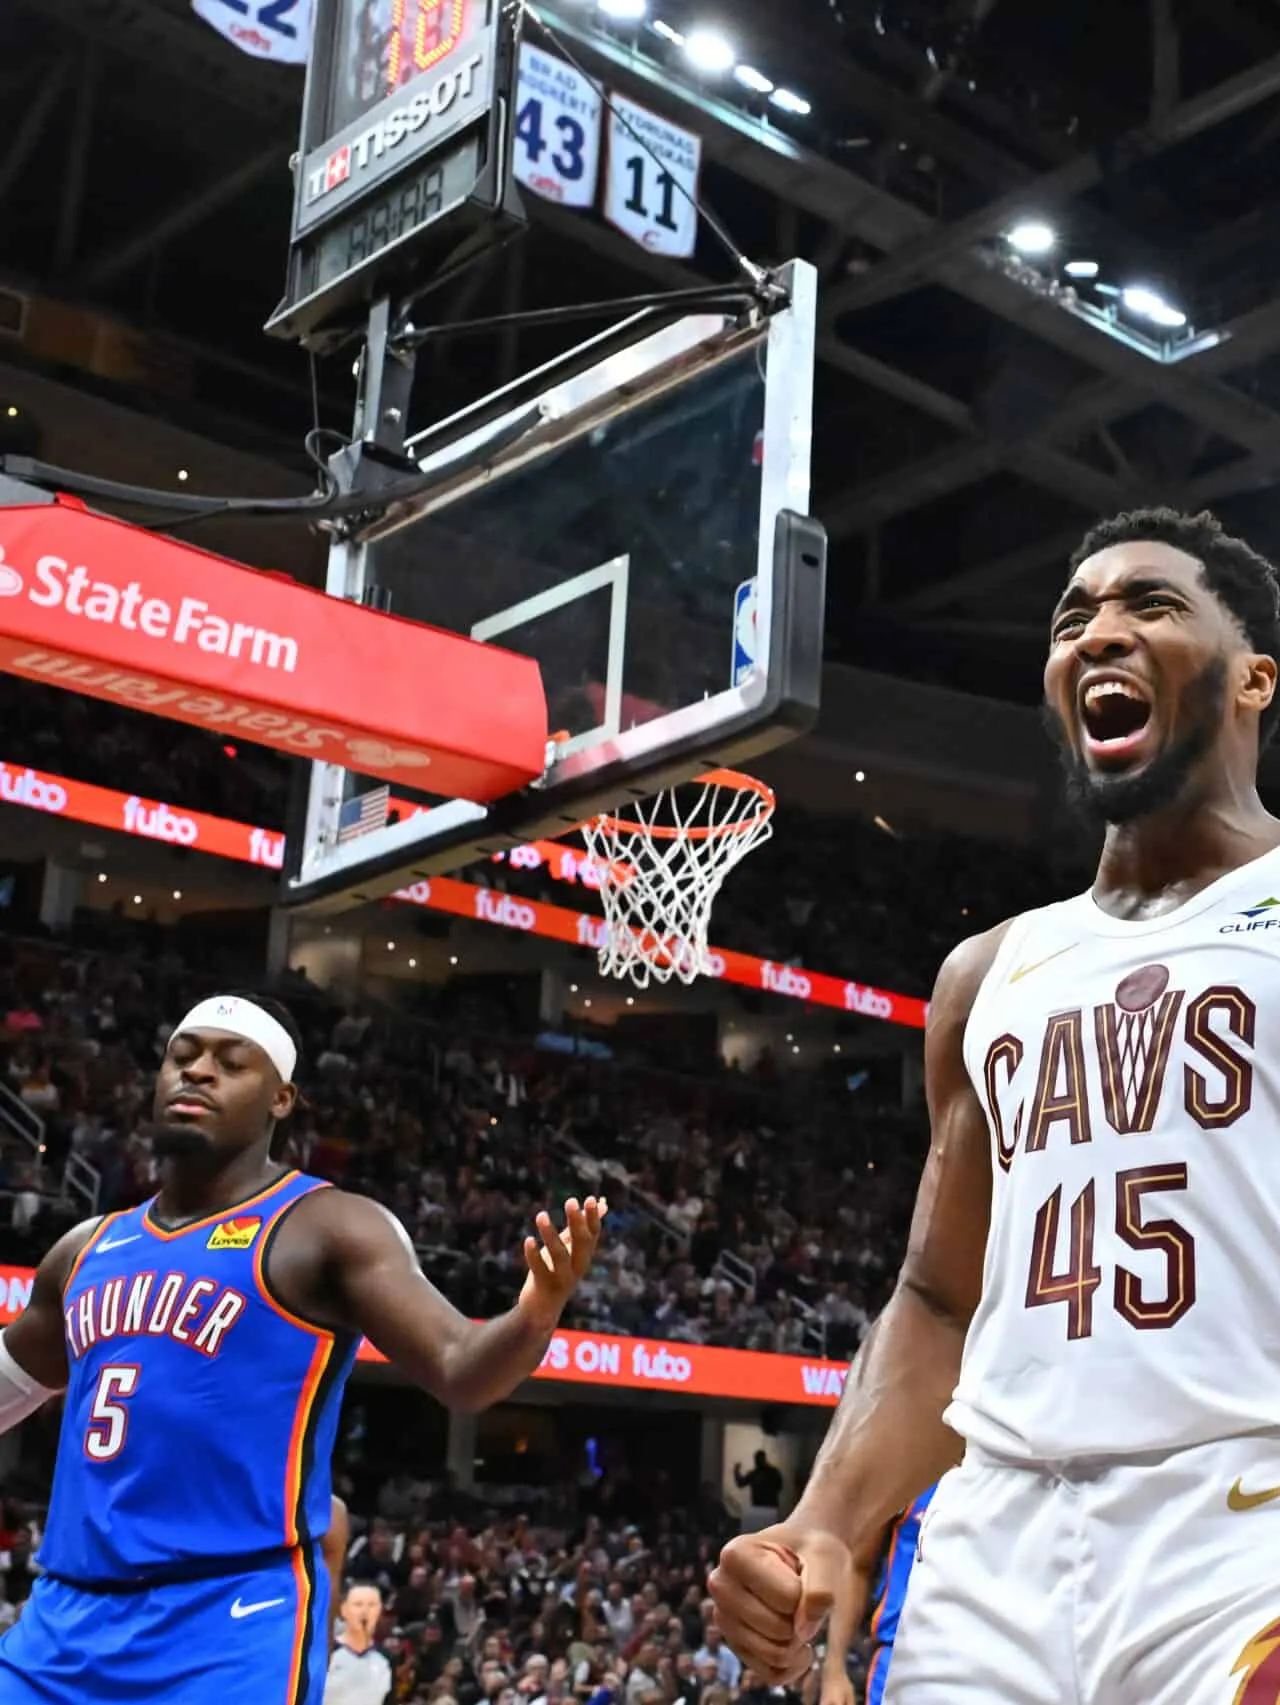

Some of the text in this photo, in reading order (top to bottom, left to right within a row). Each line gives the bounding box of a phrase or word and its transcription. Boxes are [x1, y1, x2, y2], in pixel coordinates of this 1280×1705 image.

[214, 0, 298, 39] 2
[352, 53, 483, 170] TISSOT
[515, 97, 584, 181] 43
[624, 155, 678, 233] 11
[122, 795, 198, 846] fubo
[249, 828, 286, 869] fu
[475, 890, 536, 929] fubo
[760, 959, 811, 999] fubo
[844, 982, 893, 1019] fubo
[984, 984, 1257, 1175] CAVS
[1025, 1161, 1197, 1342] 45
[64, 1271, 247, 1360] THUNDER
[575, 1341, 620, 1375] ON
[632, 1344, 692, 1382] fubo
[83, 1363, 141, 1463] 5
